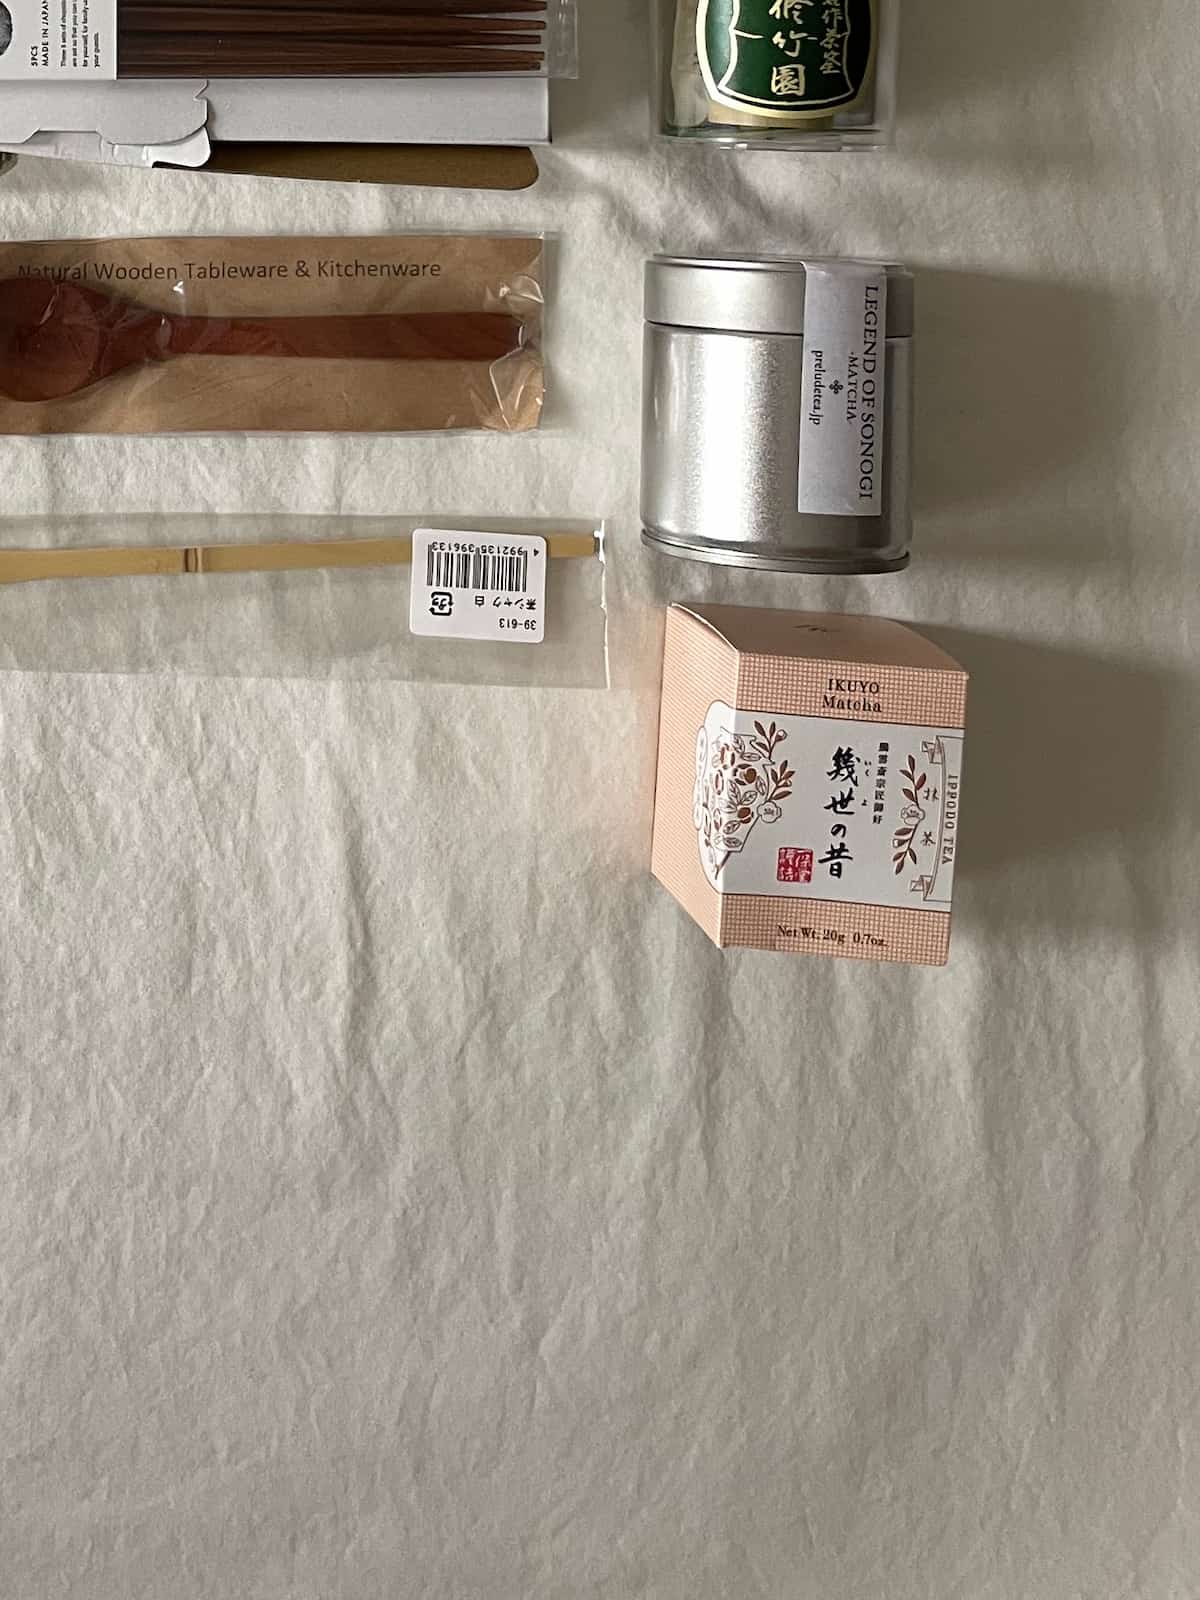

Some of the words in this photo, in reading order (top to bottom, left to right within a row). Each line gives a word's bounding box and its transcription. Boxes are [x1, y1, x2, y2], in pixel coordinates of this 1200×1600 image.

[41, 28, 49, 38] IN
[41, 41, 49, 67] MADE
[17, 262, 88, 281] Natural
[94, 262, 178, 281] Wooden
[183, 262, 289, 279] Tableware
[295, 260, 310, 277] &
[317, 259, 442, 278] Kitchenware
[862, 286, 879, 373] LEGEND
[808, 350, 826, 426] preludetea.jp
[861, 379, 876, 409] OF
[859, 413, 875, 499] SONOGI
[533, 548, 539, 557] 4
[475, 595, 485, 607] 白
[499, 618, 537, 630] 39-613
[828, 679, 880, 694] IKUYO
[822, 694, 882, 713] Matcha
[944, 773, 959, 830] IPPODO
[942, 837, 955, 865] TEA
[776, 925, 797, 937] Net
[801, 927, 820, 940] Wt.
[822, 929, 846, 944] 20g
